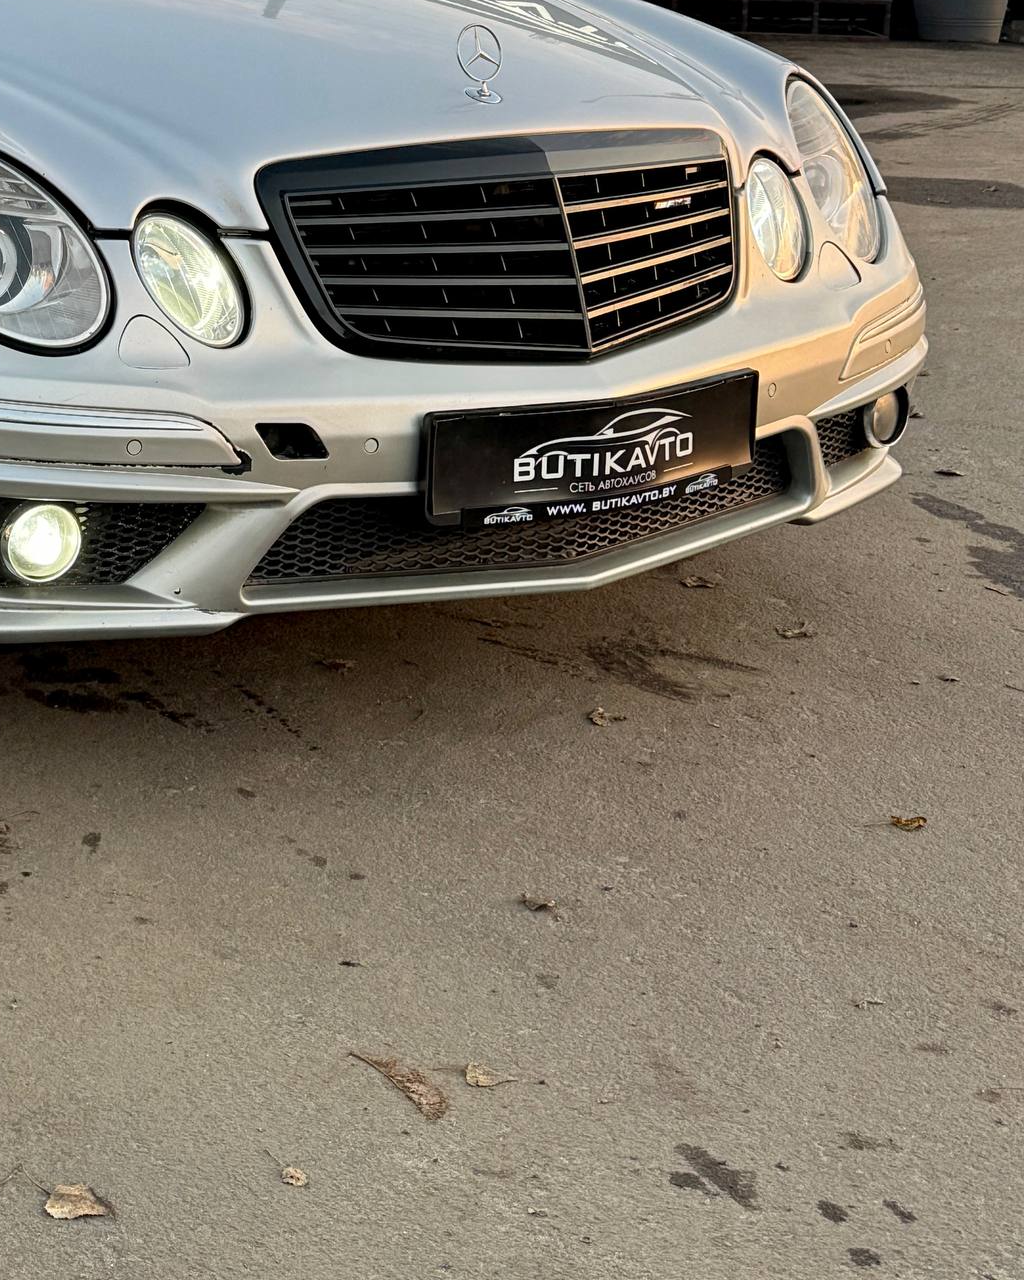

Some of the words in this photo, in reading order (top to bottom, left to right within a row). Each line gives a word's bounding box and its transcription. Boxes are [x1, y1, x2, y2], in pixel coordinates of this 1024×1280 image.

[513, 432, 694, 483] BUTIKAVTO
[569, 480, 596, 494] СЕТЬ
[597, 469, 658, 491] АВТОХАУСОВ
[546, 503, 587, 516] WWW.
[592, 484, 677, 512] BUTIKAVTO.BY
[483, 513, 533, 525] BUTIKAVTO
